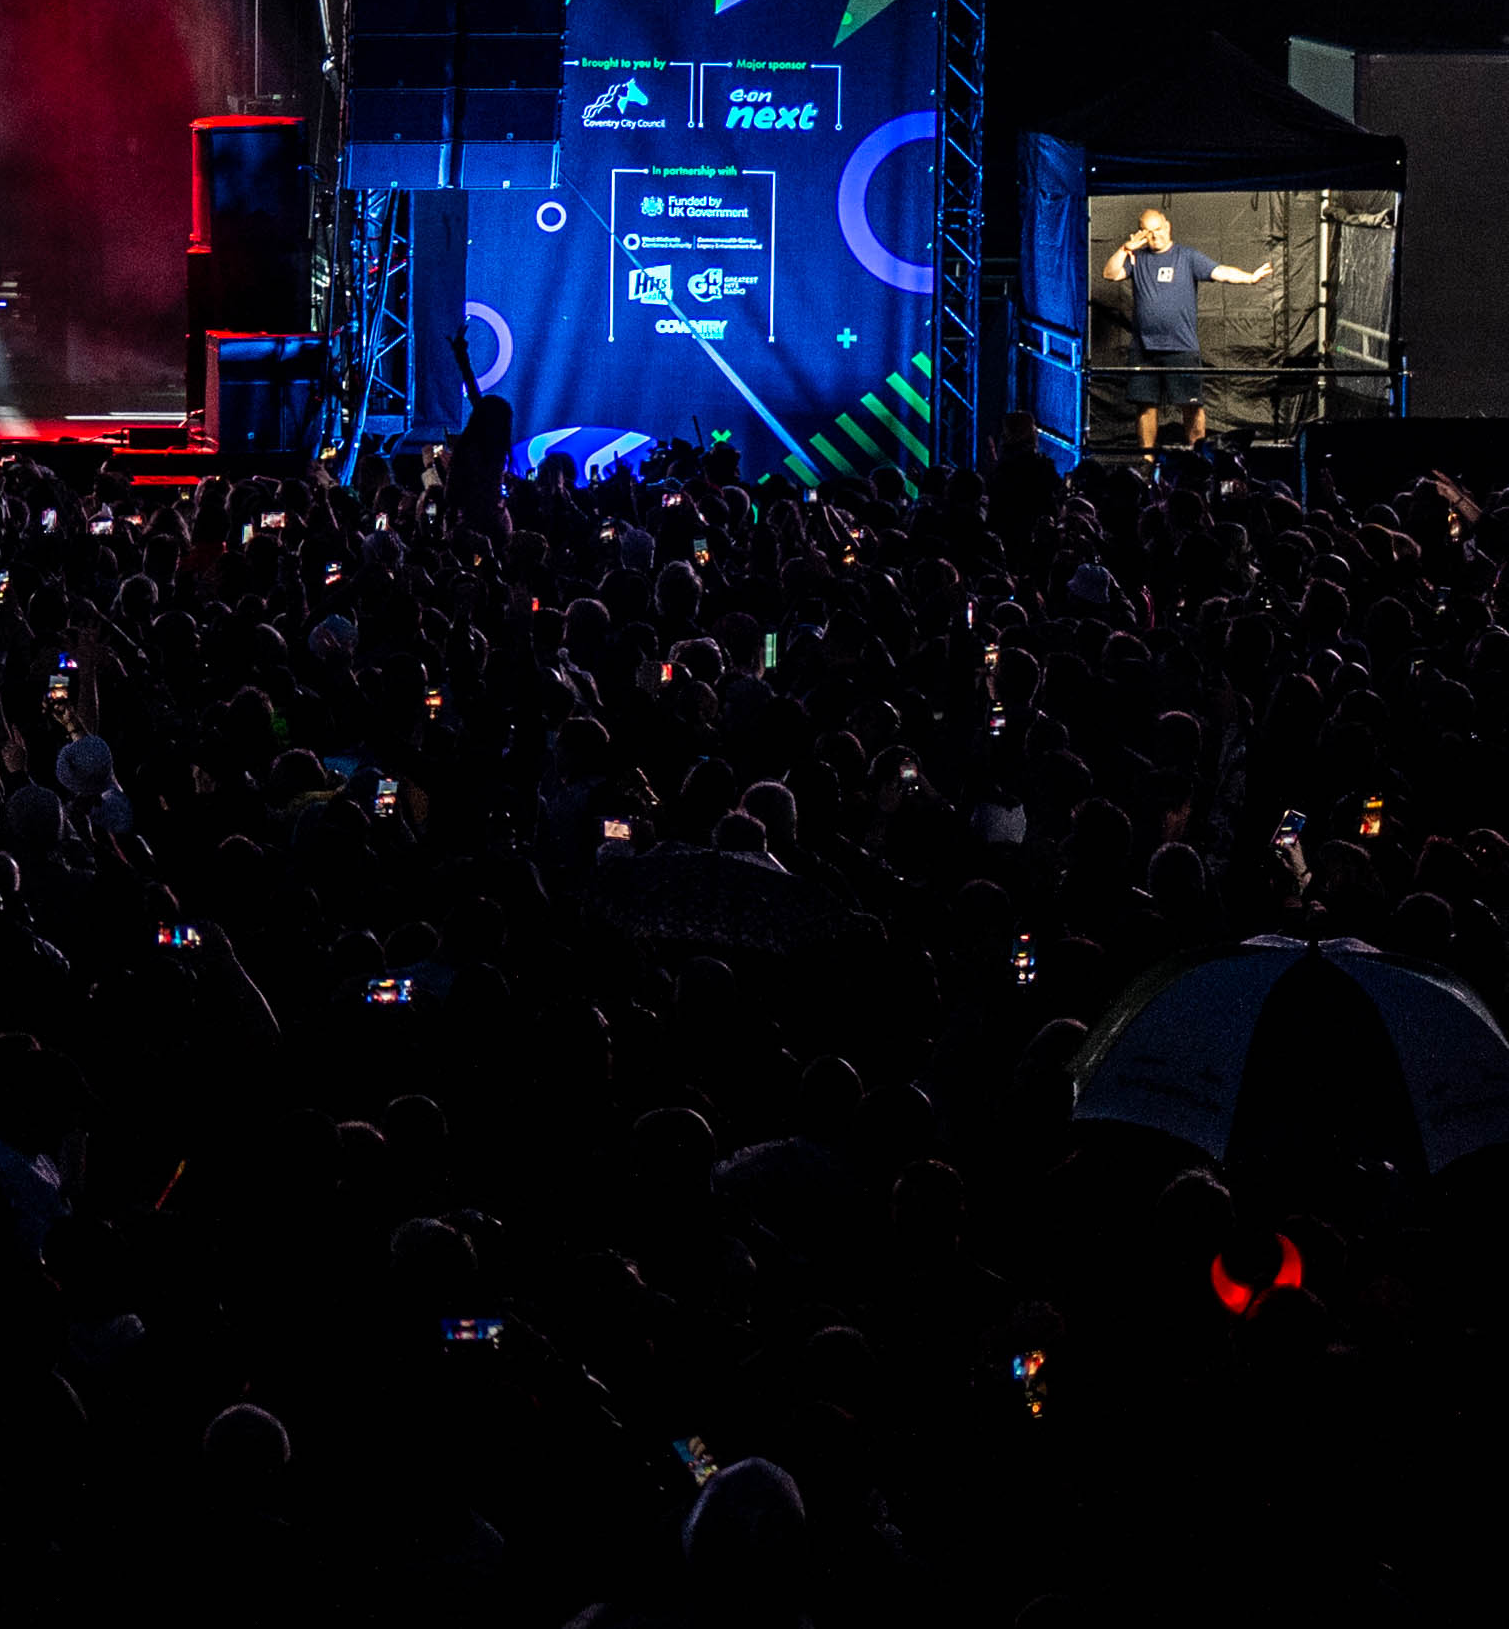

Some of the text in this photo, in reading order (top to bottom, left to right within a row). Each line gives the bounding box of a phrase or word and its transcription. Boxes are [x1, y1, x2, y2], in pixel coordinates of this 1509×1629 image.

[582, 58, 667, 70] Brought to you by
[736, 59, 807, 72] Major sponsor
[725, 102, 819, 129] next
[583, 119, 666, 129] Coventry City Council
[652, 164, 738, 178] In partnership with
[668, 196, 723, 208] Funded by
[668, 207, 749, 218] UK Government
